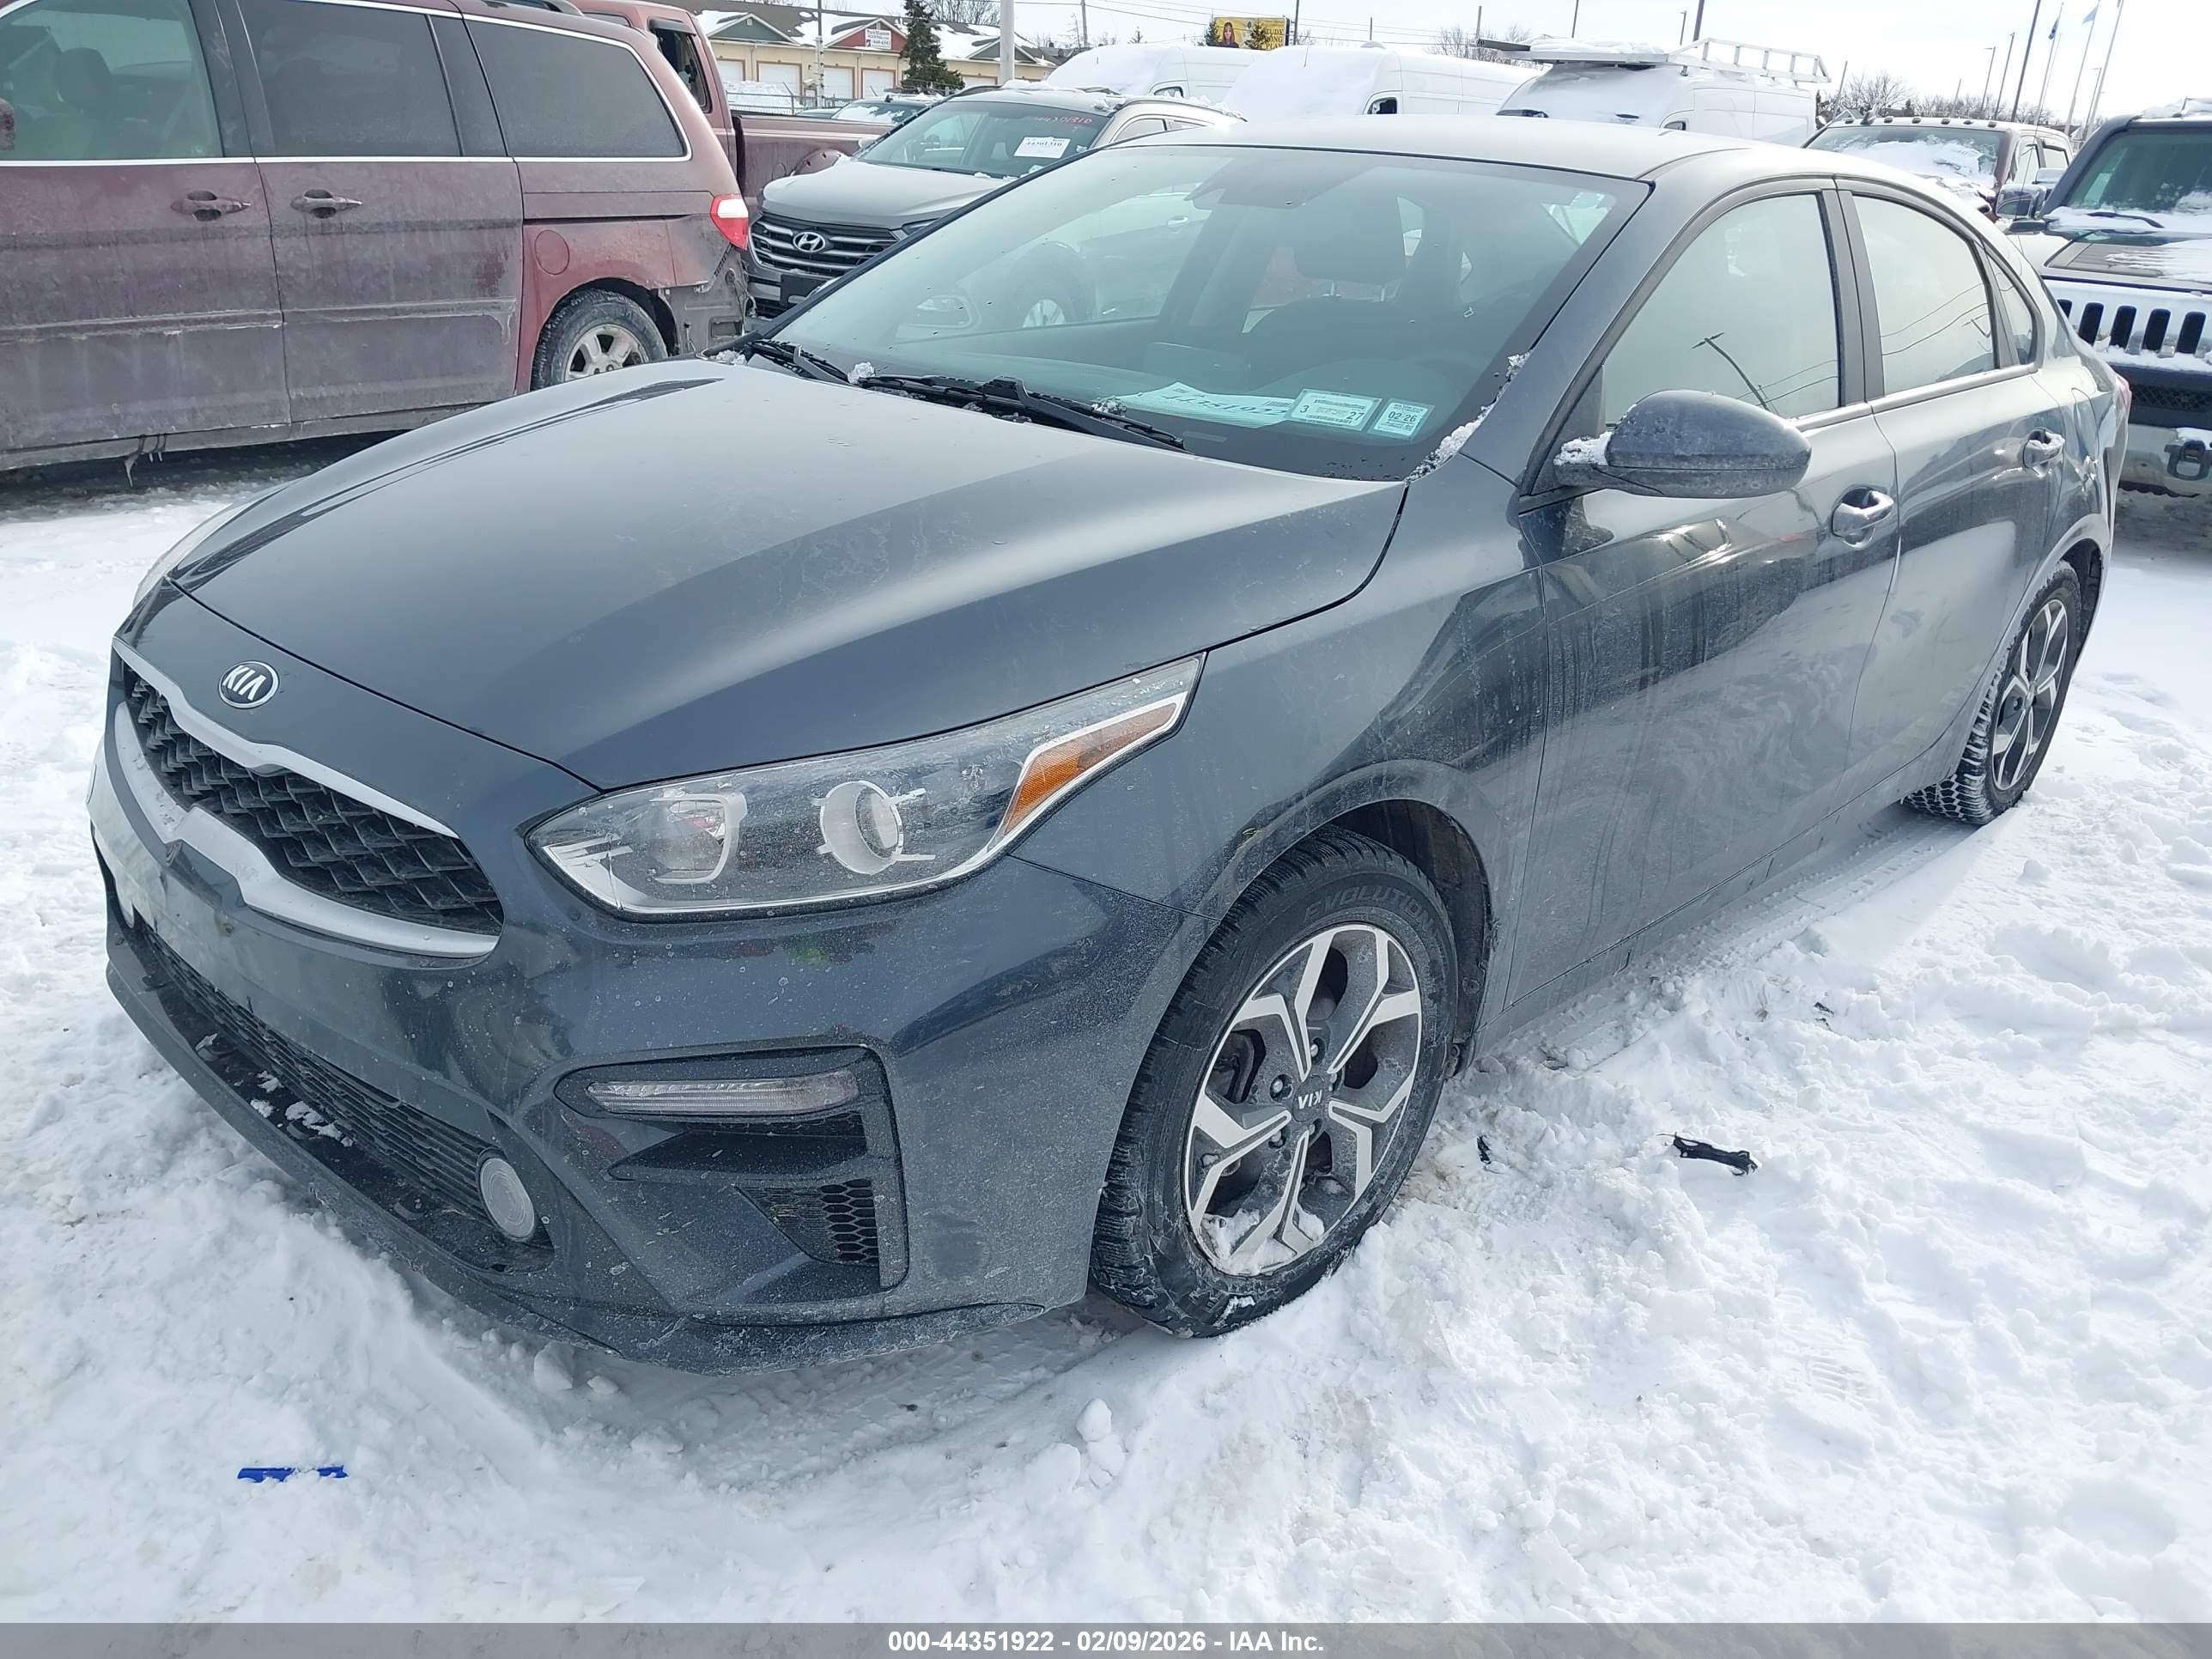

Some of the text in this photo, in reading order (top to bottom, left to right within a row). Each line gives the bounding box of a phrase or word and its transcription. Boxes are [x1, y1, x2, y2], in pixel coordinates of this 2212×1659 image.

[1299, 404, 1310, 413] 3
[1346, 411, 1364, 421] 27
[222, 665, 267, 701] KIA
[1297, 1089, 1323, 1109] KIA
